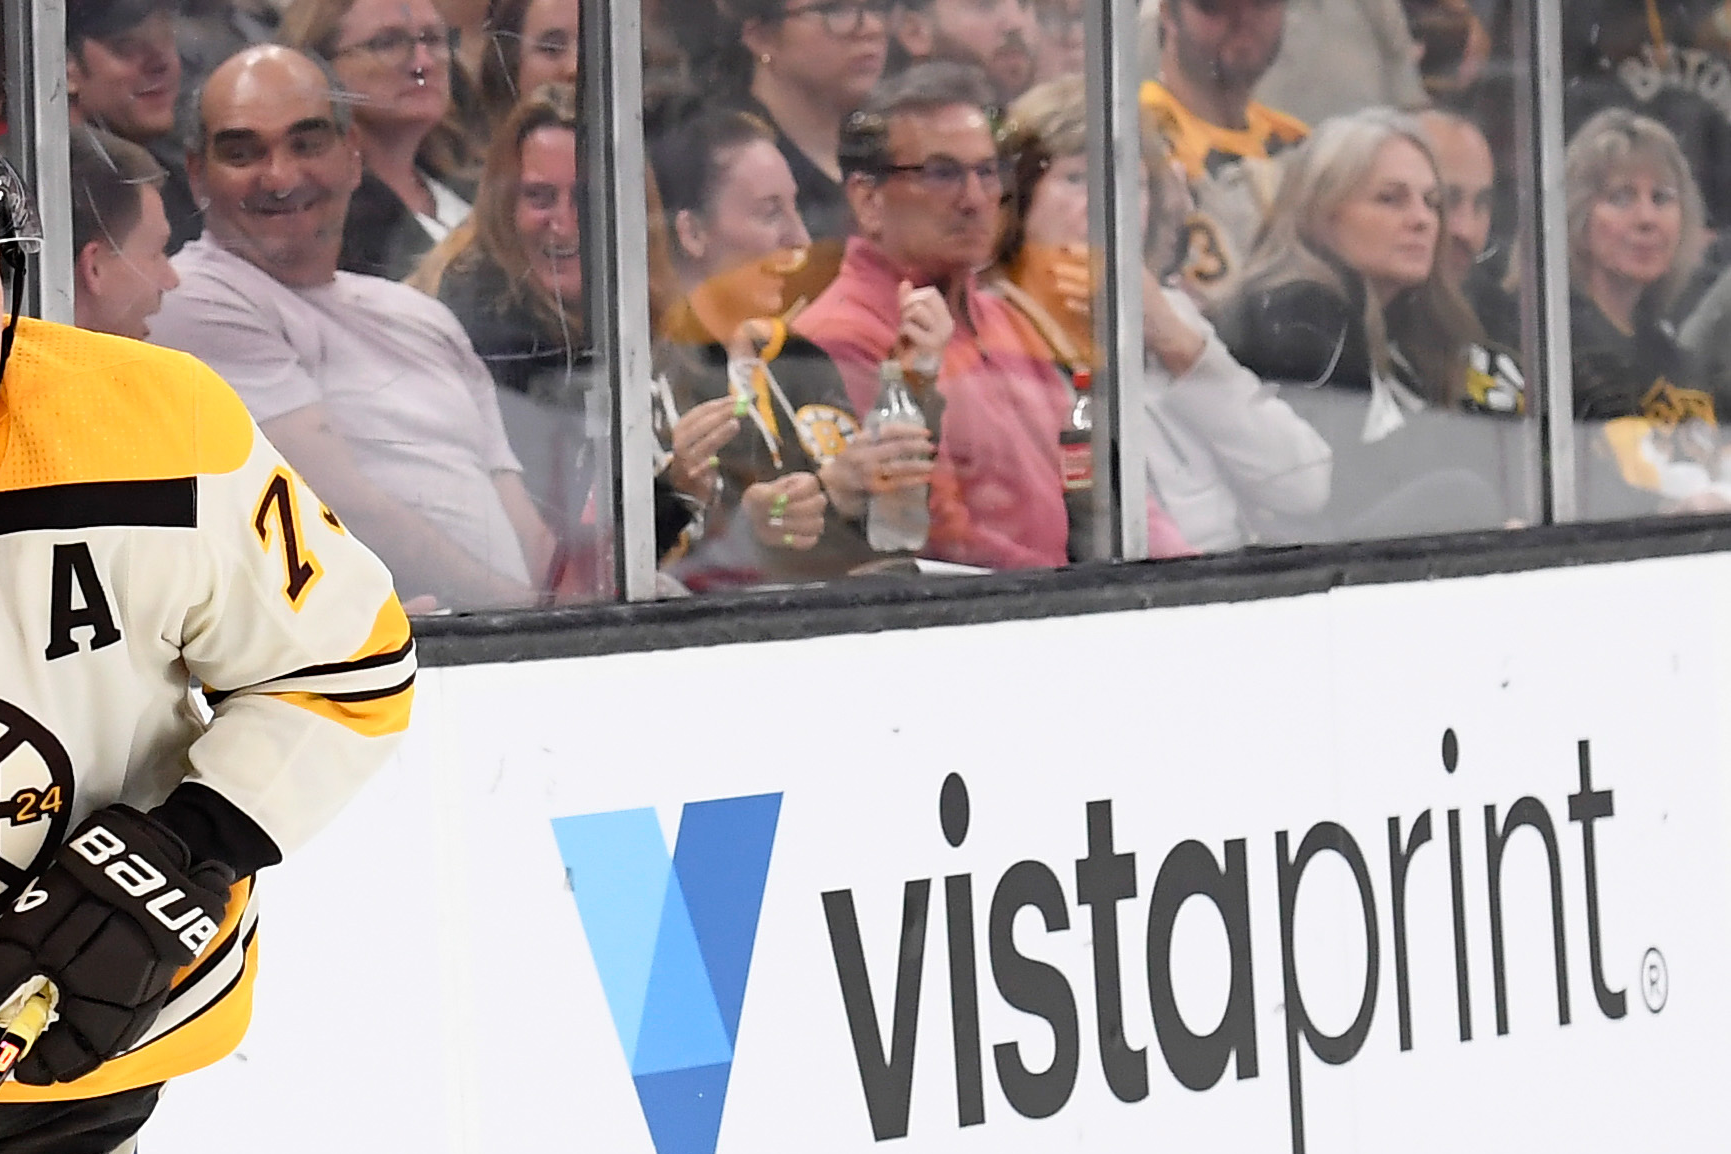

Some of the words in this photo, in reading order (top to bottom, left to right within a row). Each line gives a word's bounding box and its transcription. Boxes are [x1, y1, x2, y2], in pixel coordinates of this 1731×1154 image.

[45, 541, 122, 661] A
[16, 785, 63, 822] 24
[69, 825, 220, 958] BAUE
